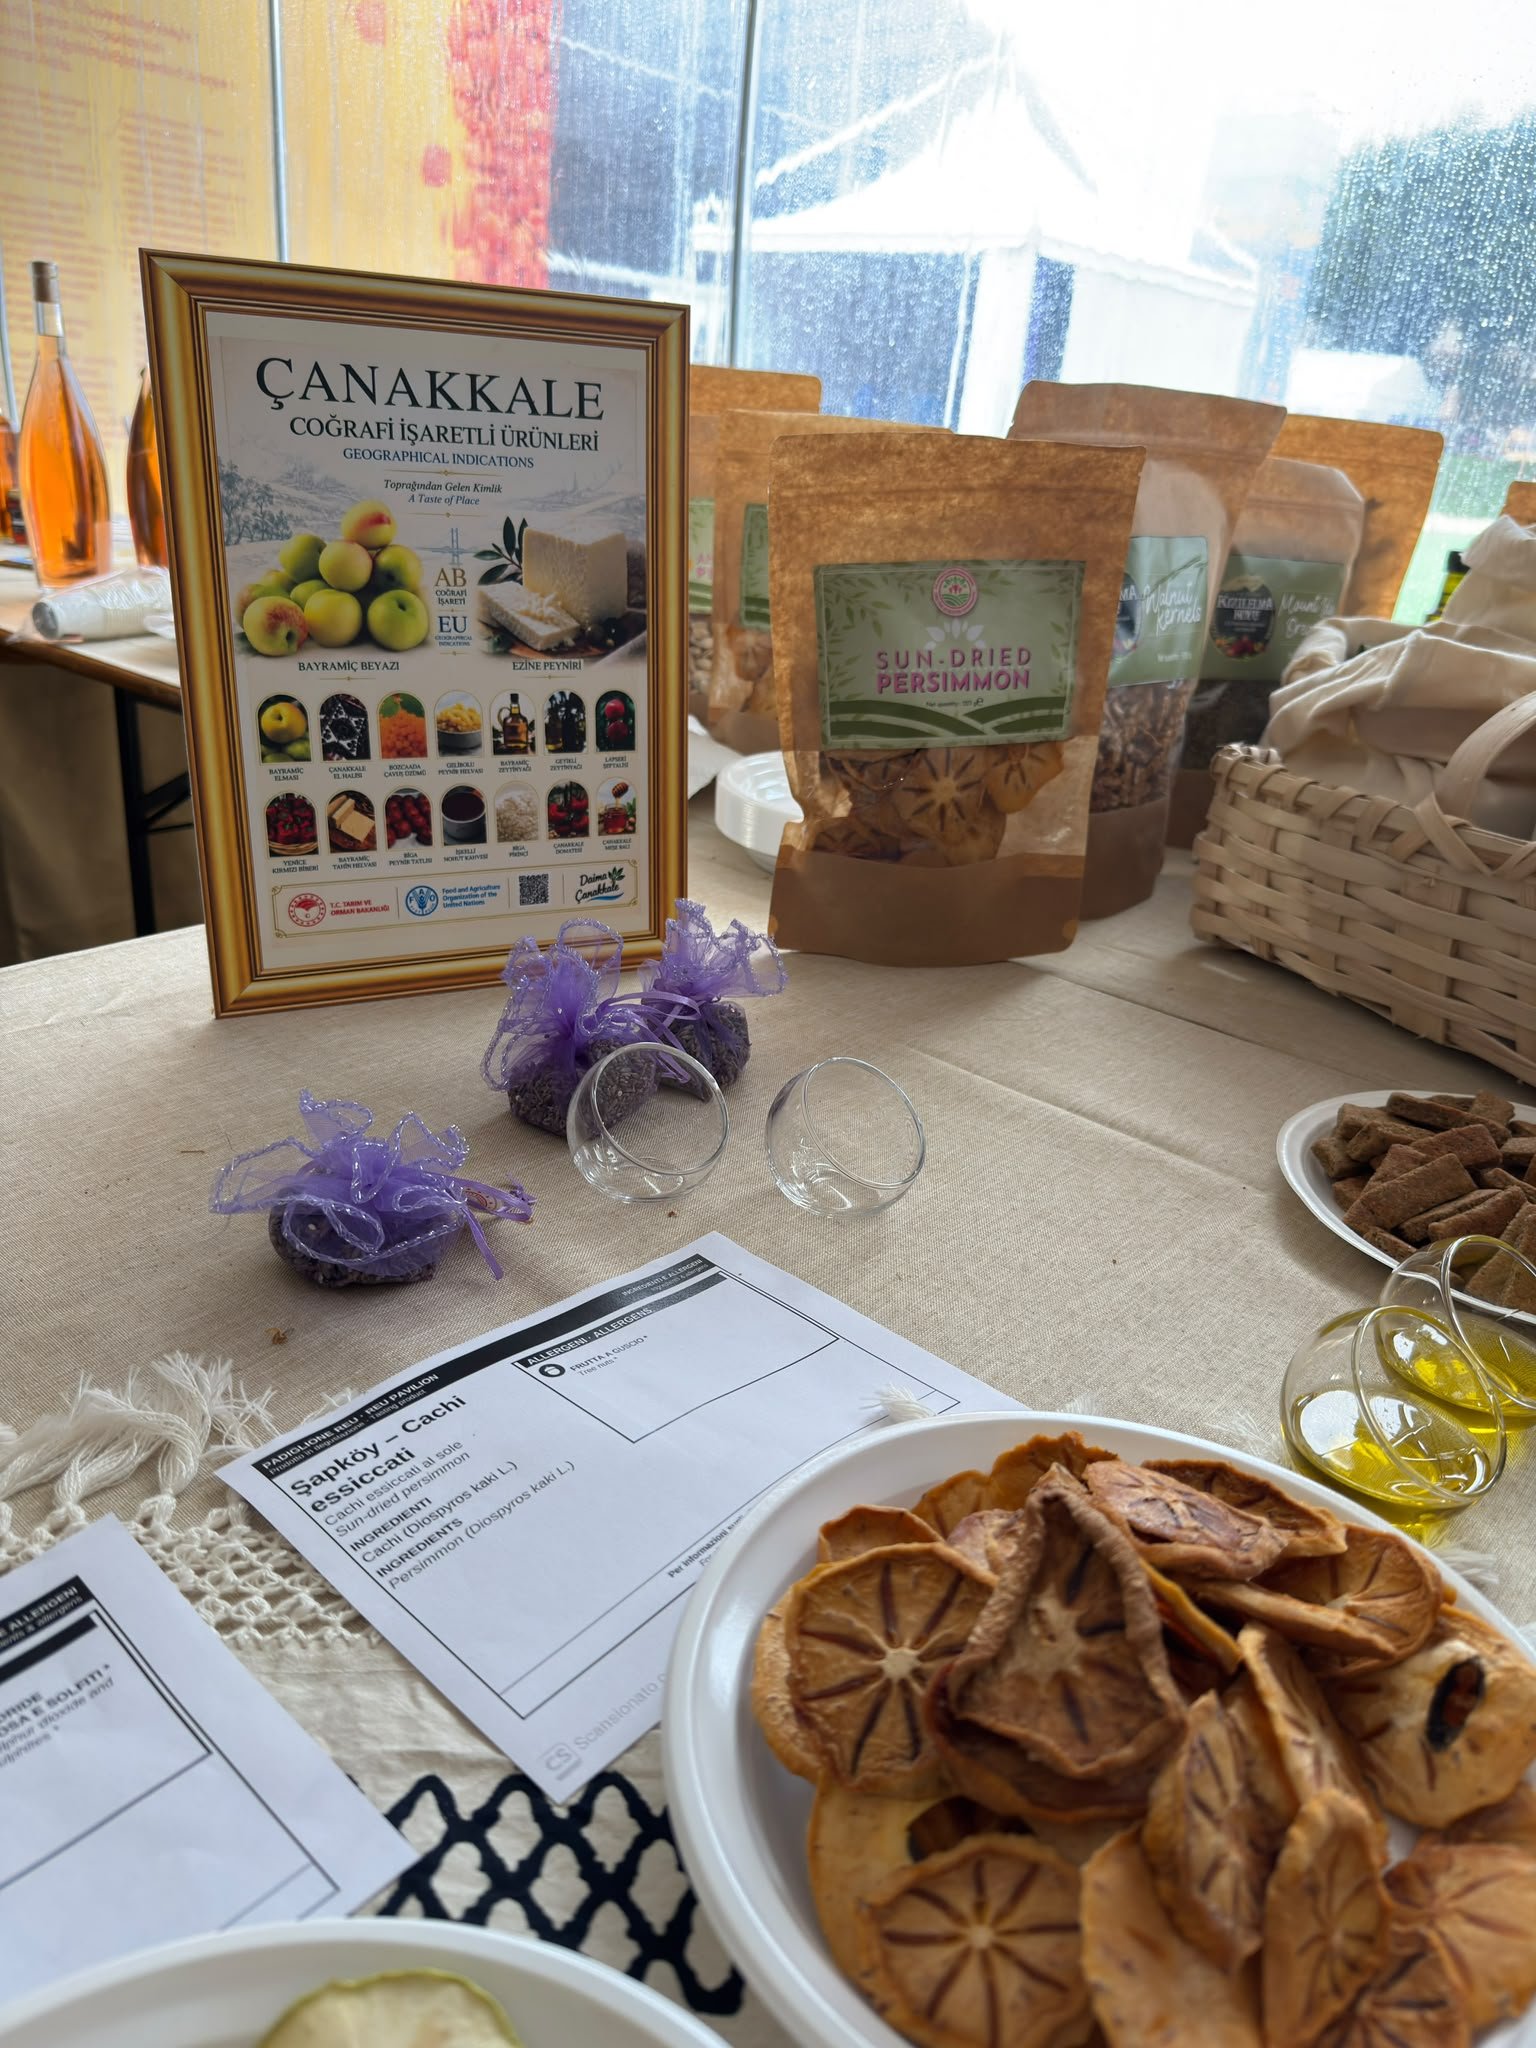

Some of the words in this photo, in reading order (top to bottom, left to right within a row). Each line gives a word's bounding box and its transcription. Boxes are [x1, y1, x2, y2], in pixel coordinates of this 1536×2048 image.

[256, 357, 605, 420] ÇANAKKALE
[290, 414, 394, 440] COĞRAFİ
[400, 418, 496, 446] İŞARETLİ
[500, 425, 600, 452] ÜRÜNLERİ
[343, 448, 450, 464] GEOGRAPHICAL
[452, 454, 534, 468] INDICATIONS
[384, 479, 442, 492] Toprağından
[445, 481, 472, 492] Gelen
[473, 482, 502, 494] Kimlik
[408, 494, 416, 503] A
[418, 494, 446, 504] Taste
[445, 495, 454, 506] of
[456, 496, 480, 506] Place
[435, 568, 466, 587] AB
[438, 598, 466, 606] İŞARETİ
[438, 616, 467, 633] EU
[298, 660, 358, 672] BAYRAMİÇ
[360, 661, 400, 671] BEYAZI
[512, 660, 540, 671] EZİNE
[542, 660, 582, 670] PEYNİRİ
[876, 647, 1031, 670] SUN-DRIED
[876, 671, 1030, 694] PERSIMMON
[328, 766, 366, 774] ÇANAKKALE
[580, 872, 607, 886] Daima
[443, 893, 479, 902] Organization
[575, 882, 620, 904] Çanakkale
[331, 908, 355, 916] ORMAN
[356, 905, 390, 914] BAKANLIĞI
[622, 1278, 663, 1296] INGREDIENTI
[668, 1259, 703, 1278] ALLERGENI
[527, 1336, 587, 1366] ALLERGENI
[593, 1307, 653, 1339] ALLERGENS
[570, 1354, 604, 1372] FRUTTA
[605, 1350, 612, 1358] A
[577, 1364, 597, 1377] Tree
[262, 1428, 334, 1470] PADIGLIONE
[334, 1416, 359, 1435] REU
[364, 1401, 390, 1420] REU
[391, 1374, 439, 1402] PAVILION
[269, 1454, 305, 1476] Prodotto
[306, 1449, 312, 1457] in
[313, 1422, 365, 1454] degustazione
[370, 1403, 399, 1423] Tasting
[400, 1389, 426, 1408] product
[291, 1443, 381, 1497] Şapköy
[401, 1395, 467, 1433] Cachi
[311, 1447, 416, 1513] essiccati
[324, 1498, 365, 1526] Cachi
[366, 1465, 421, 1501] essiccati
[424, 1457, 435, 1468] al
[436, 1440, 464, 1461] sole
[335, 1492, 401, 1538] Sun-dried
[402, 1452, 470, 1499] persimmon
[362, 1534, 402, 1563] Cachi
[403, 1491, 472, 1538] (Diospyros
[470, 1473, 499, 1493] kaki
[497, 1461, 518, 1476] L.)
[350, 1497, 432, 1552] INGREDIENTI
[389, 1534, 465, 1590] Persimmon
[465, 1491, 532, 1539] (Diospyros
[530, 1473, 557, 1493] kaki
[556, 1460, 575, 1476] L.)
[376, 1518, 463, 1577] INGREDIENTS
[668, 1565, 684, 1578] Per
[682, 1529, 728, 1566] informazioni
[8, 1586, 79, 1631] ALLERGENI
[37, 1596, 83, 1627] allergens
[89, 1677, 114, 1699] and
[32, 1706, 45, 1716] E
[545, 1748, 571, 1770] CS
[574, 1680, 658, 1750] Scansionato
